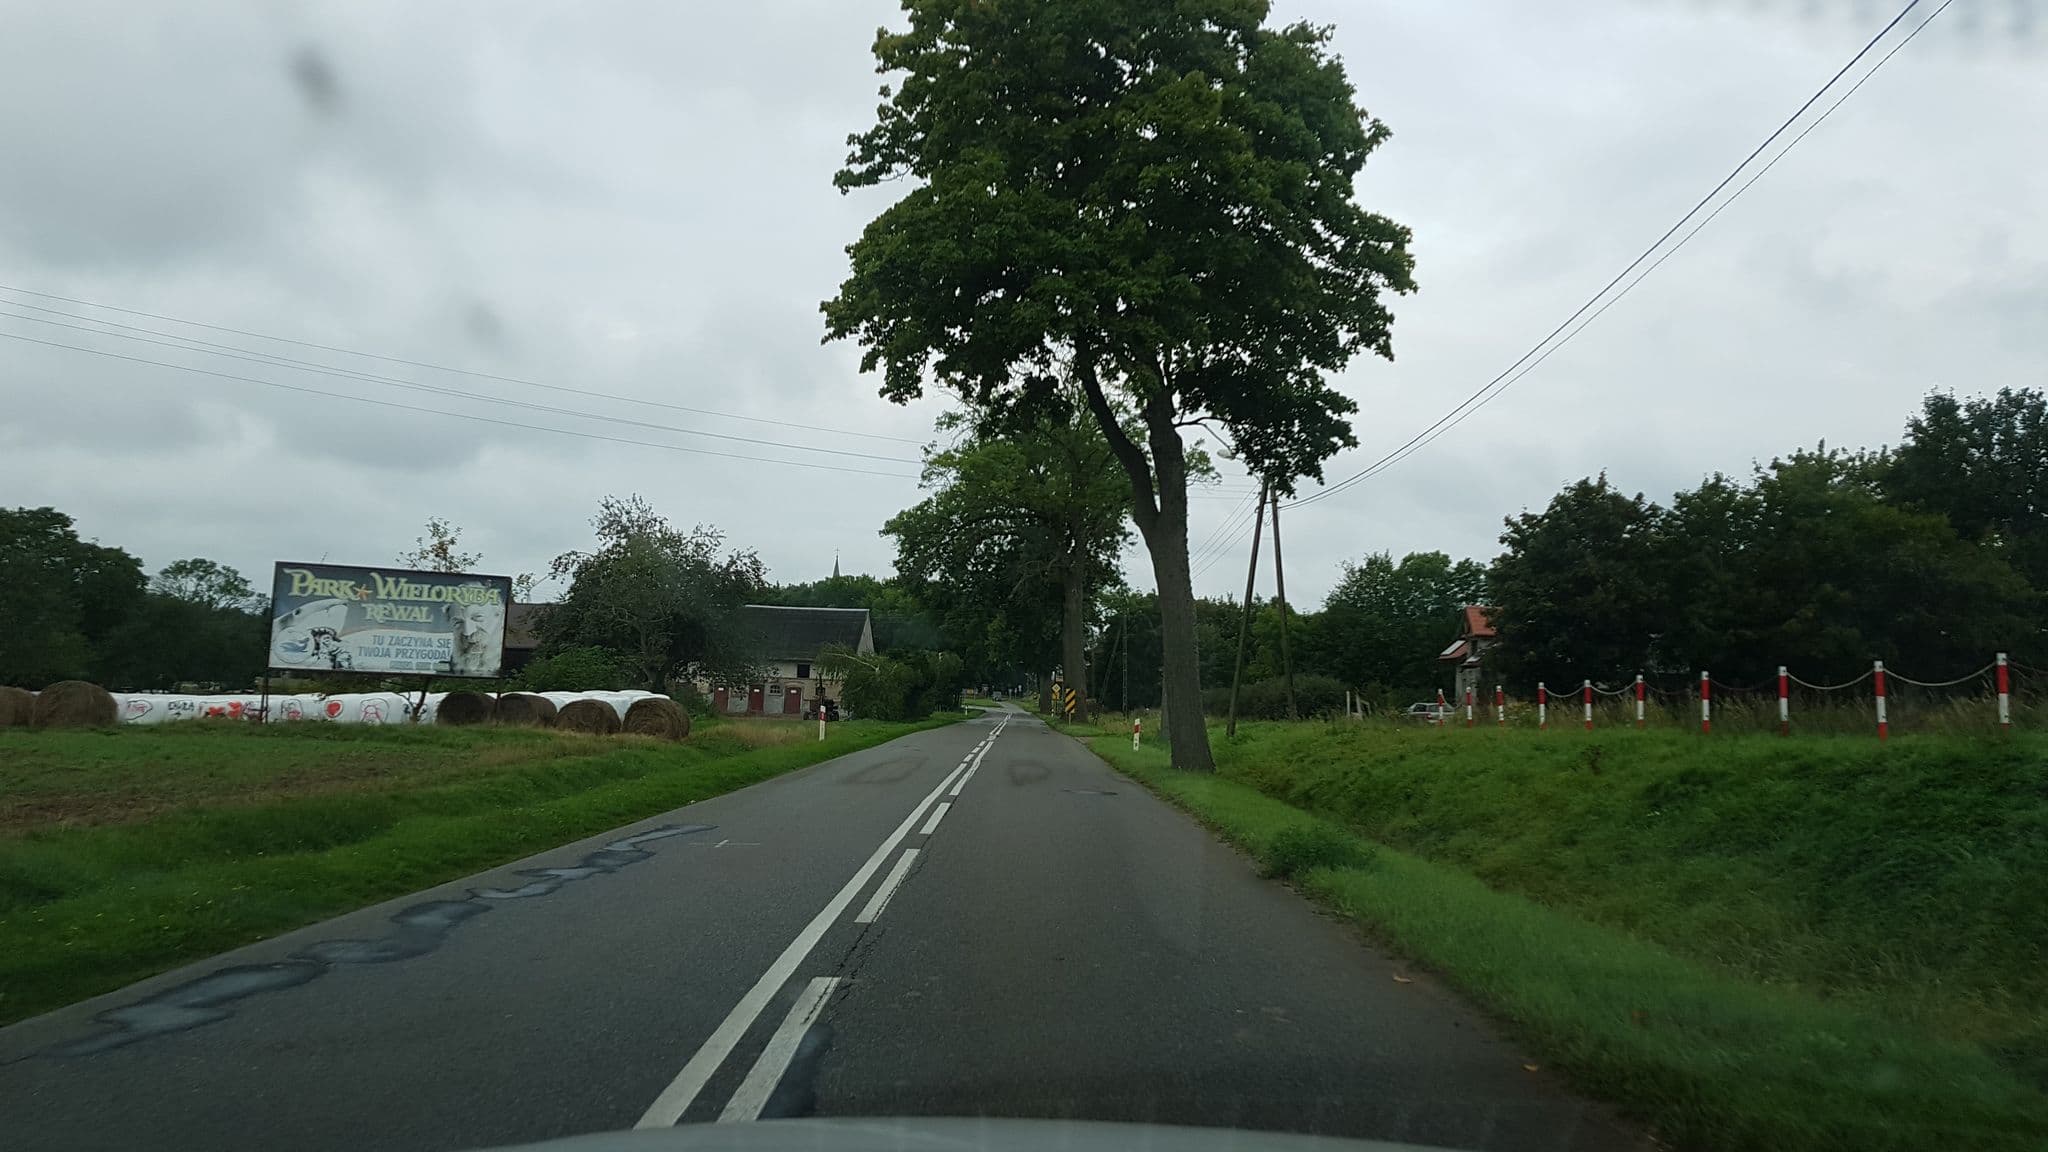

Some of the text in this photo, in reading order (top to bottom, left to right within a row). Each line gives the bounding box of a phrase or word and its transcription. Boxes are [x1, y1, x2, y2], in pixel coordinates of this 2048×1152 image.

[283, 568, 501, 605] PARK WIELORYBA
[361, 603, 434, 623] REWAL
[372, 634, 384, 646] TU
[388, 635, 433, 648] ZACZYNA
[358, 646, 450, 660] TWOJA PRZYGODA!
